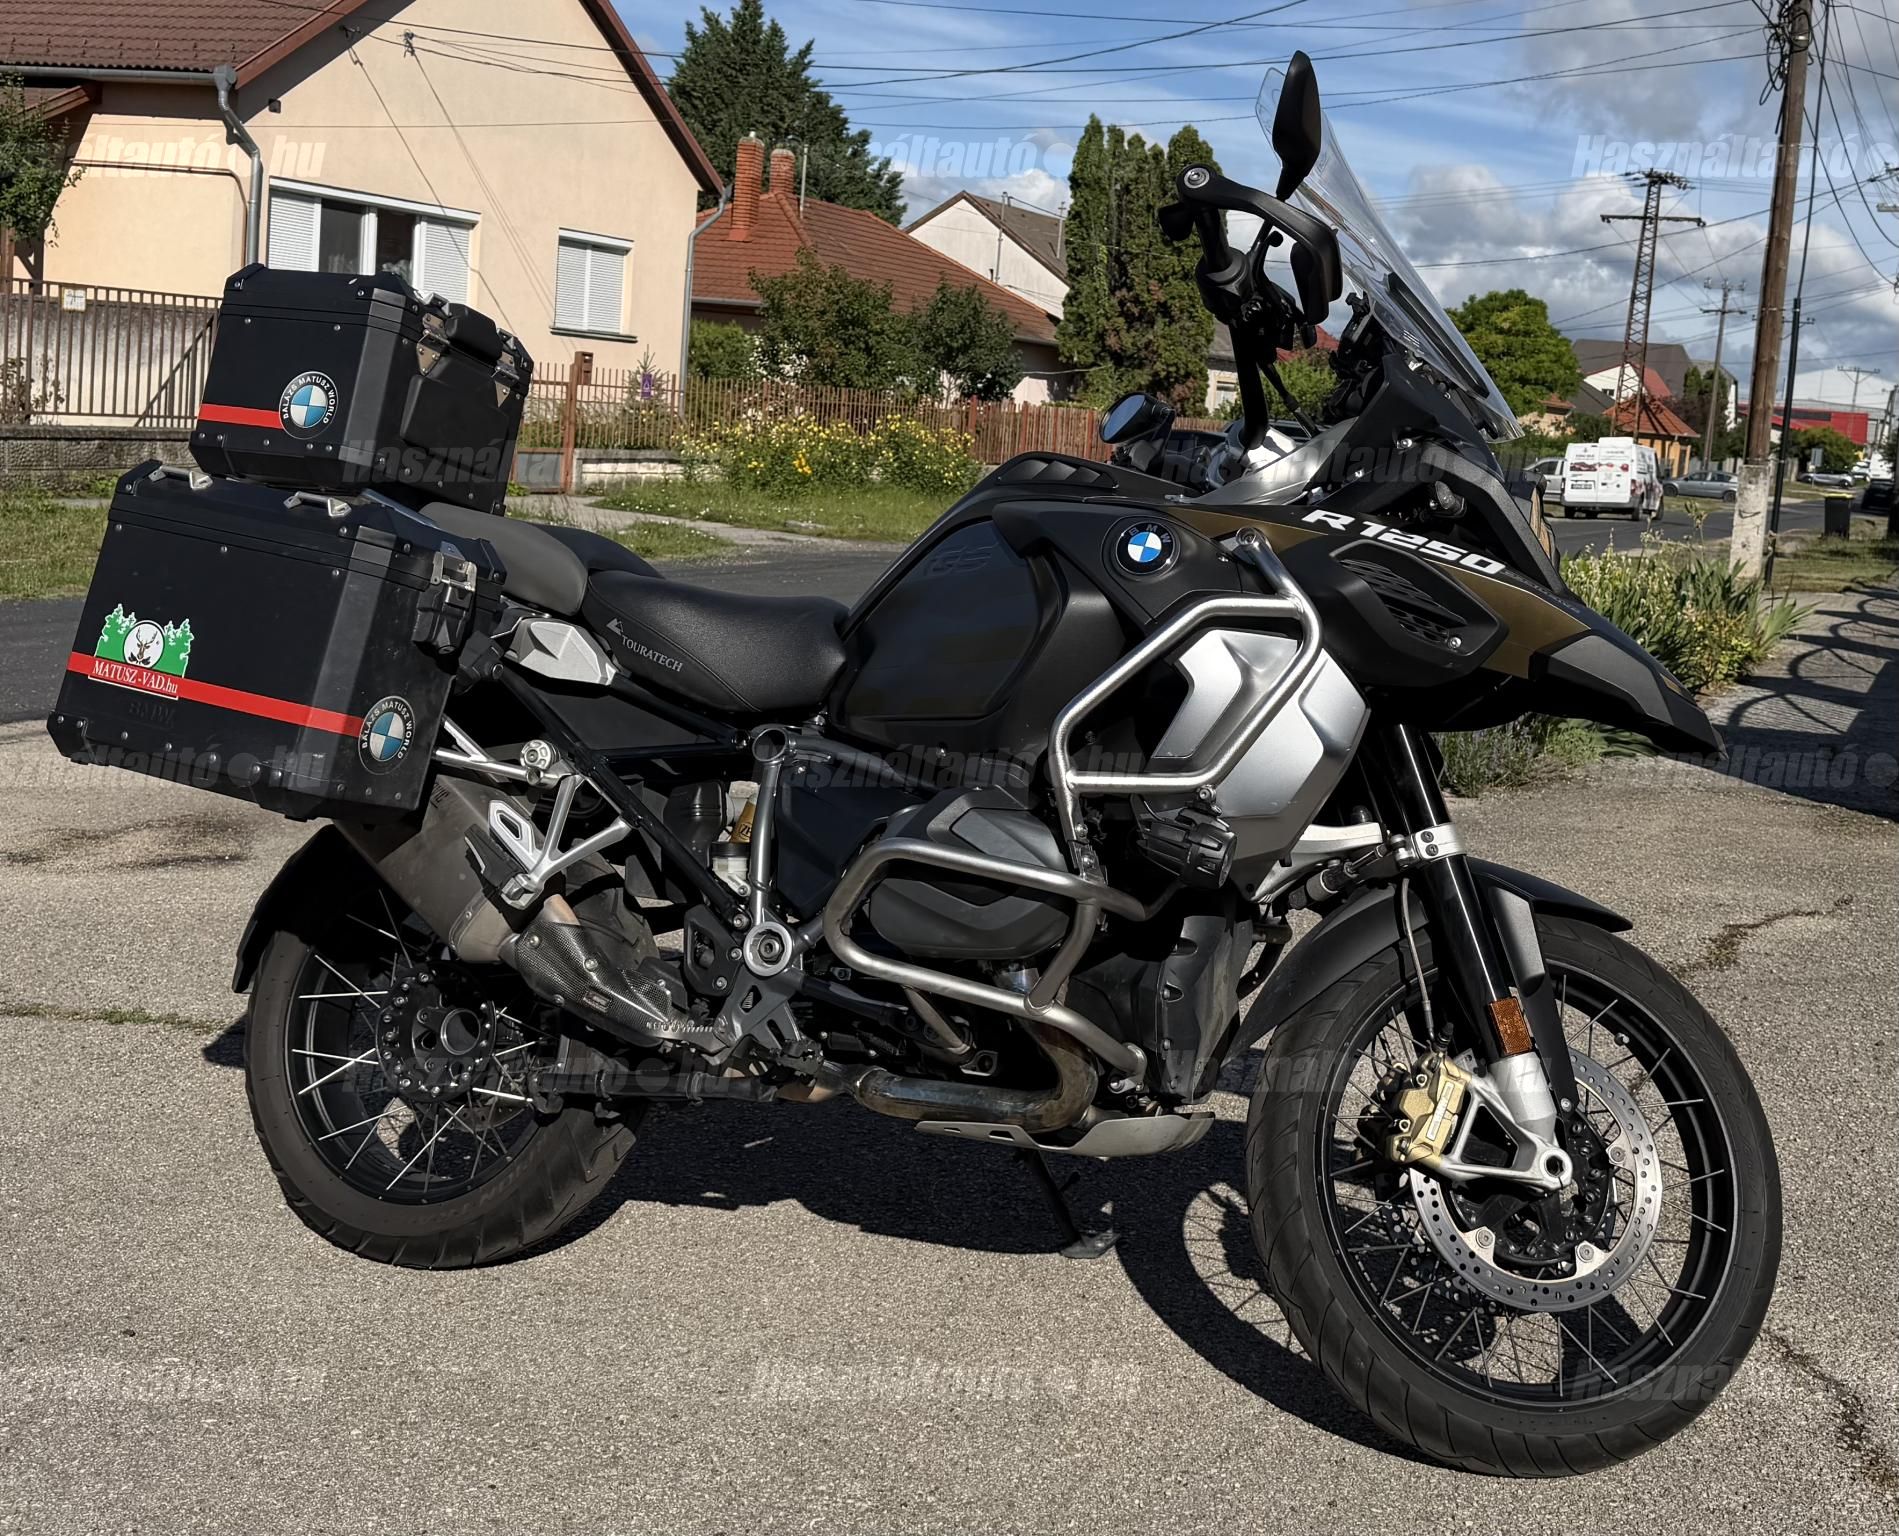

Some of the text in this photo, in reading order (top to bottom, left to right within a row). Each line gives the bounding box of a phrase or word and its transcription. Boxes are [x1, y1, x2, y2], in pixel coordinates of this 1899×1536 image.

[323, 389, 336, 424] WORLD
[1128, 523, 1172, 543] BMW
[1301, 509, 1507, 575] R 1250
[621, 634, 684, 672] TOURATECH
[381, 700, 410, 720] MATUSZ
[397, 720, 413, 759] WORLD
